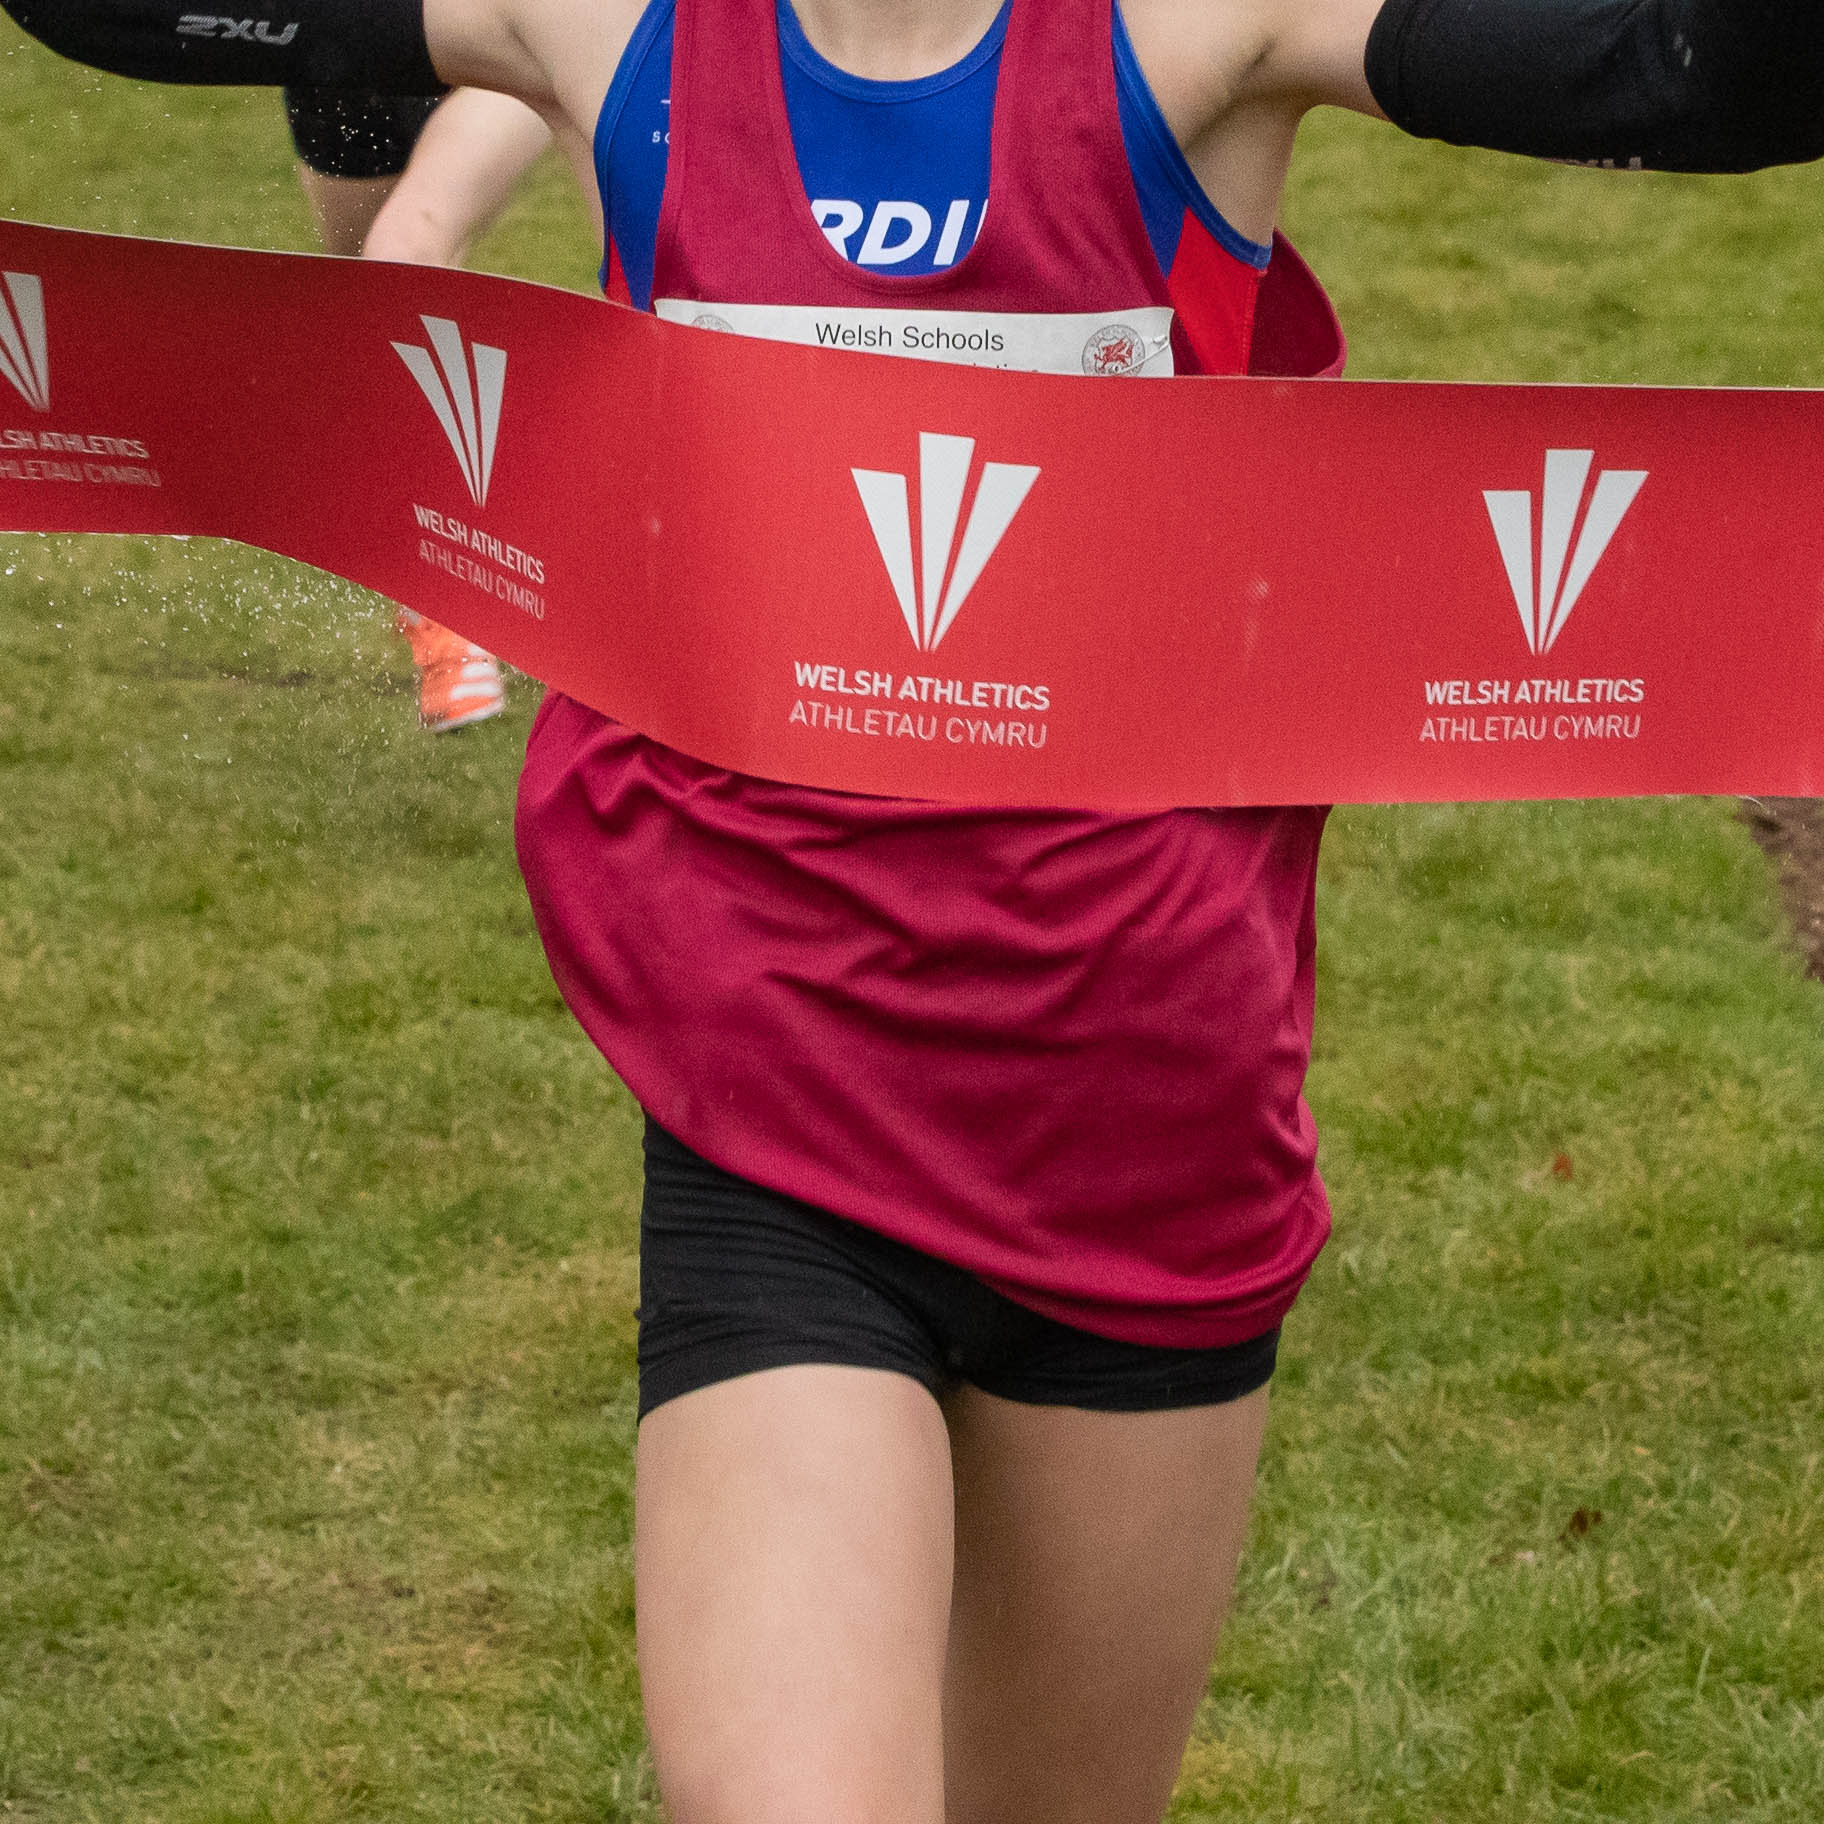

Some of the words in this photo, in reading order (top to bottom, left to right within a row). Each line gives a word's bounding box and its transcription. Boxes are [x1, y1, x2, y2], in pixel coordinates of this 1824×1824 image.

[175, 13, 300, 46] 2XU
[810, 199, 988, 266] RDI
[815, 322, 893, 349] Welsh
[902, 325, 1005, 352] Schools
[39, 429, 150, 460] ATHLETICS
[84, 461, 162, 488] CYMRU
[412, 503, 468, 548] WELSH
[470, 530, 546, 586] ATHLETICS
[418, 539, 495, 595] ATHLETAU
[495, 574, 546, 621] CYMRU
[793, 660, 893, 699] WELSH
[897, 675, 1051, 712] ATHLETICS
[1424, 679, 1511, 706] WELSH
[1513, 678, 1646, 705] ATHLETICS
[788, 699, 938, 742] ATHLETAU
[945, 717, 1049, 750] CYMRU
[1418, 715, 1548, 743] ATHLETAU
[1552, 714, 1642, 740] CYMRU
